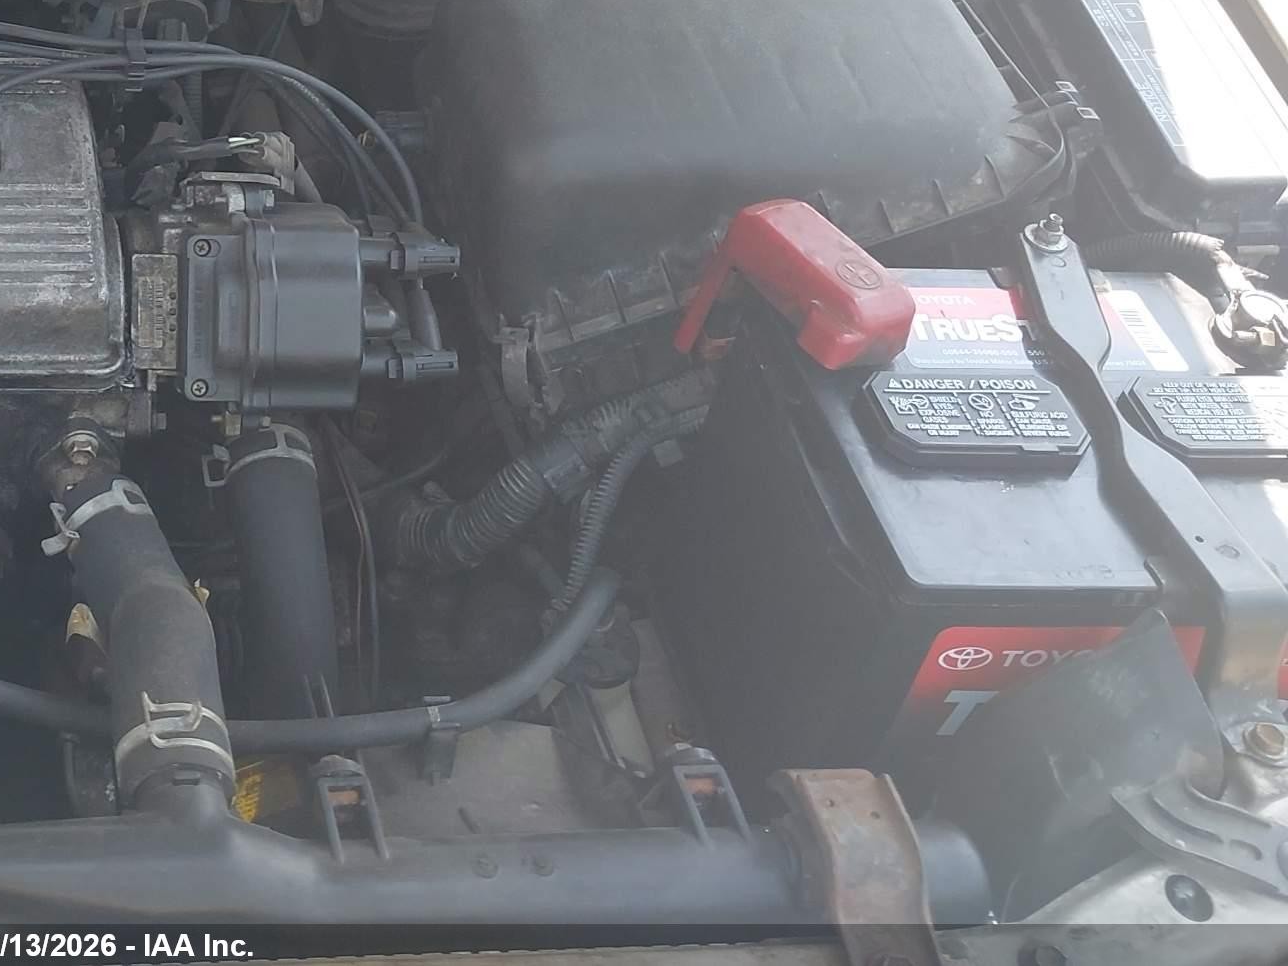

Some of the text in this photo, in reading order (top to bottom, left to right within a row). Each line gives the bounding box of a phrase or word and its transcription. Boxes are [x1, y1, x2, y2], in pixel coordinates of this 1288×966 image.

[1135, 82, 1169, 123] NOTICE
[916, 295, 977, 306] OYOTA
[900, 378, 966, 390] DANGER
[980, 378, 1038, 390] POISON
[918, 409, 961, 417] EXPLOSIVE
[979, 410, 995, 418] NO
[1011, 411, 1047, 419] SULFURIC
